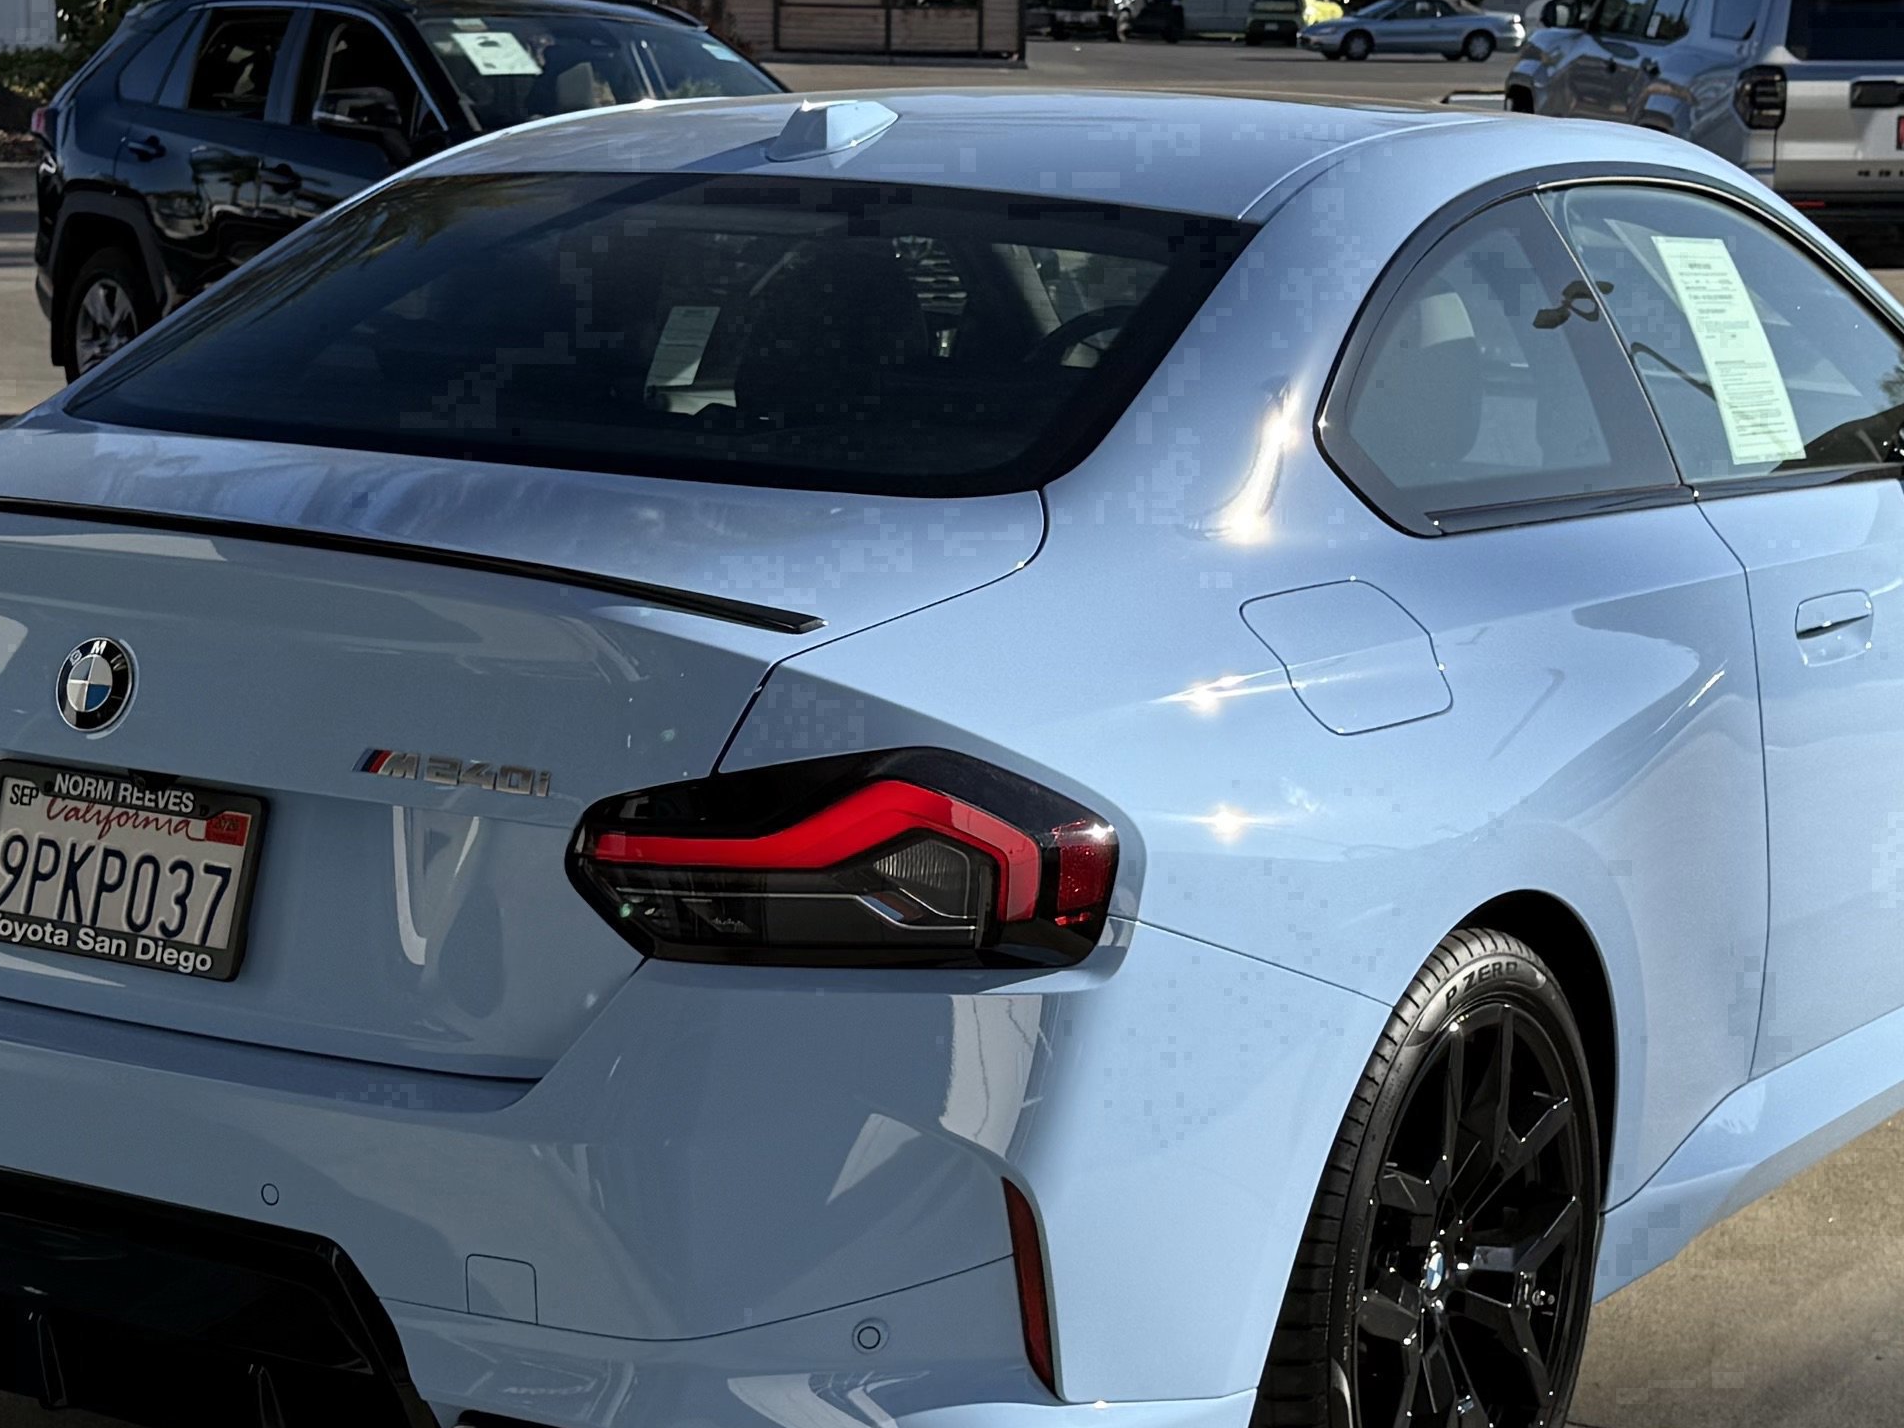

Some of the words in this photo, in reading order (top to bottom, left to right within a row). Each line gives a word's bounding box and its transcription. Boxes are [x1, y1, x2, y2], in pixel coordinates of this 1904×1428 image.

[9, 783, 39, 806] SEP
[53, 772, 114, 801] NORM
[117, 783, 194, 813] REEVES
[374, 750, 552, 797] M240i
[45, 797, 206, 840] California
[77, 928, 126, 957] San
[135, 938, 213, 973] Diego
[1445, 984, 1457, 1009] P
[1462, 961, 1518, 992] ZERO
